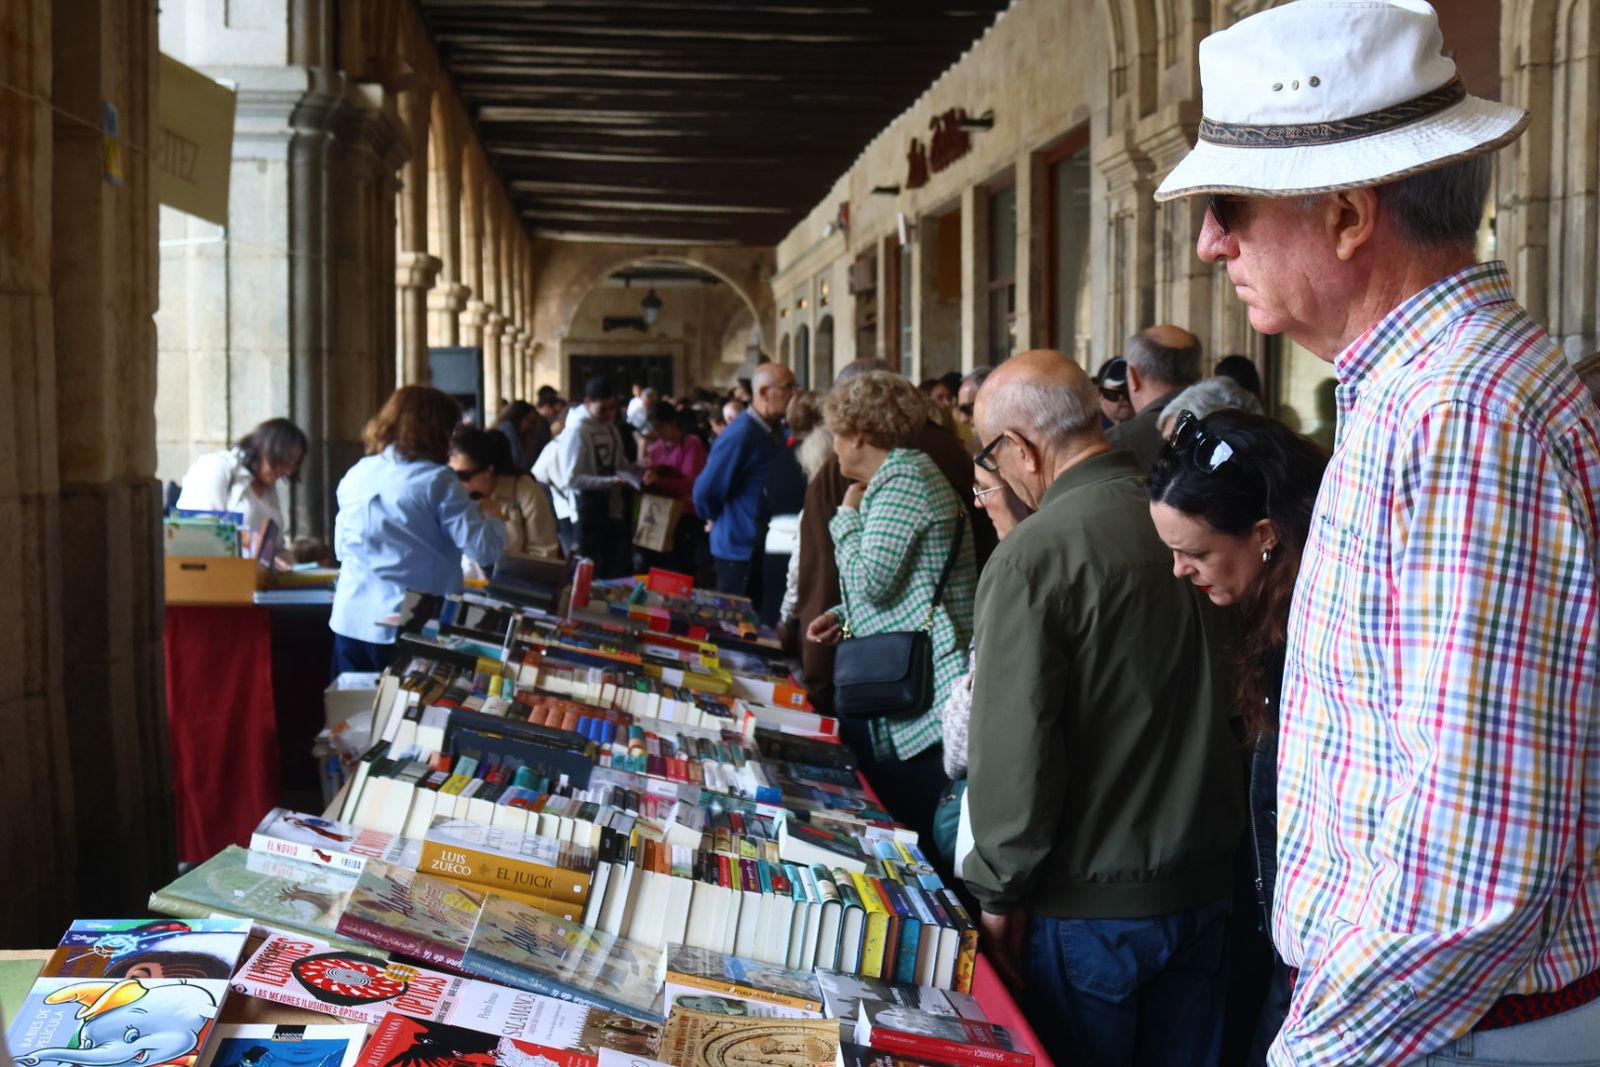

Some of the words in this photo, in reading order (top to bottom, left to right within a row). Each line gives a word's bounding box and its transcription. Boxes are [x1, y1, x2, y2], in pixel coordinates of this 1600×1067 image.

[267, 840, 275, 851] EL
[277, 843, 298, 857] NOVIO
[441, 850, 466, 865] LUIS
[431, 859, 472, 876] ZUECO
[496, 866, 510, 881] EL
[254, 988, 267, 998] LAS
[269, 991, 300, 1006] MEJORES
[302, 999, 337, 1015] ILUSIONES
